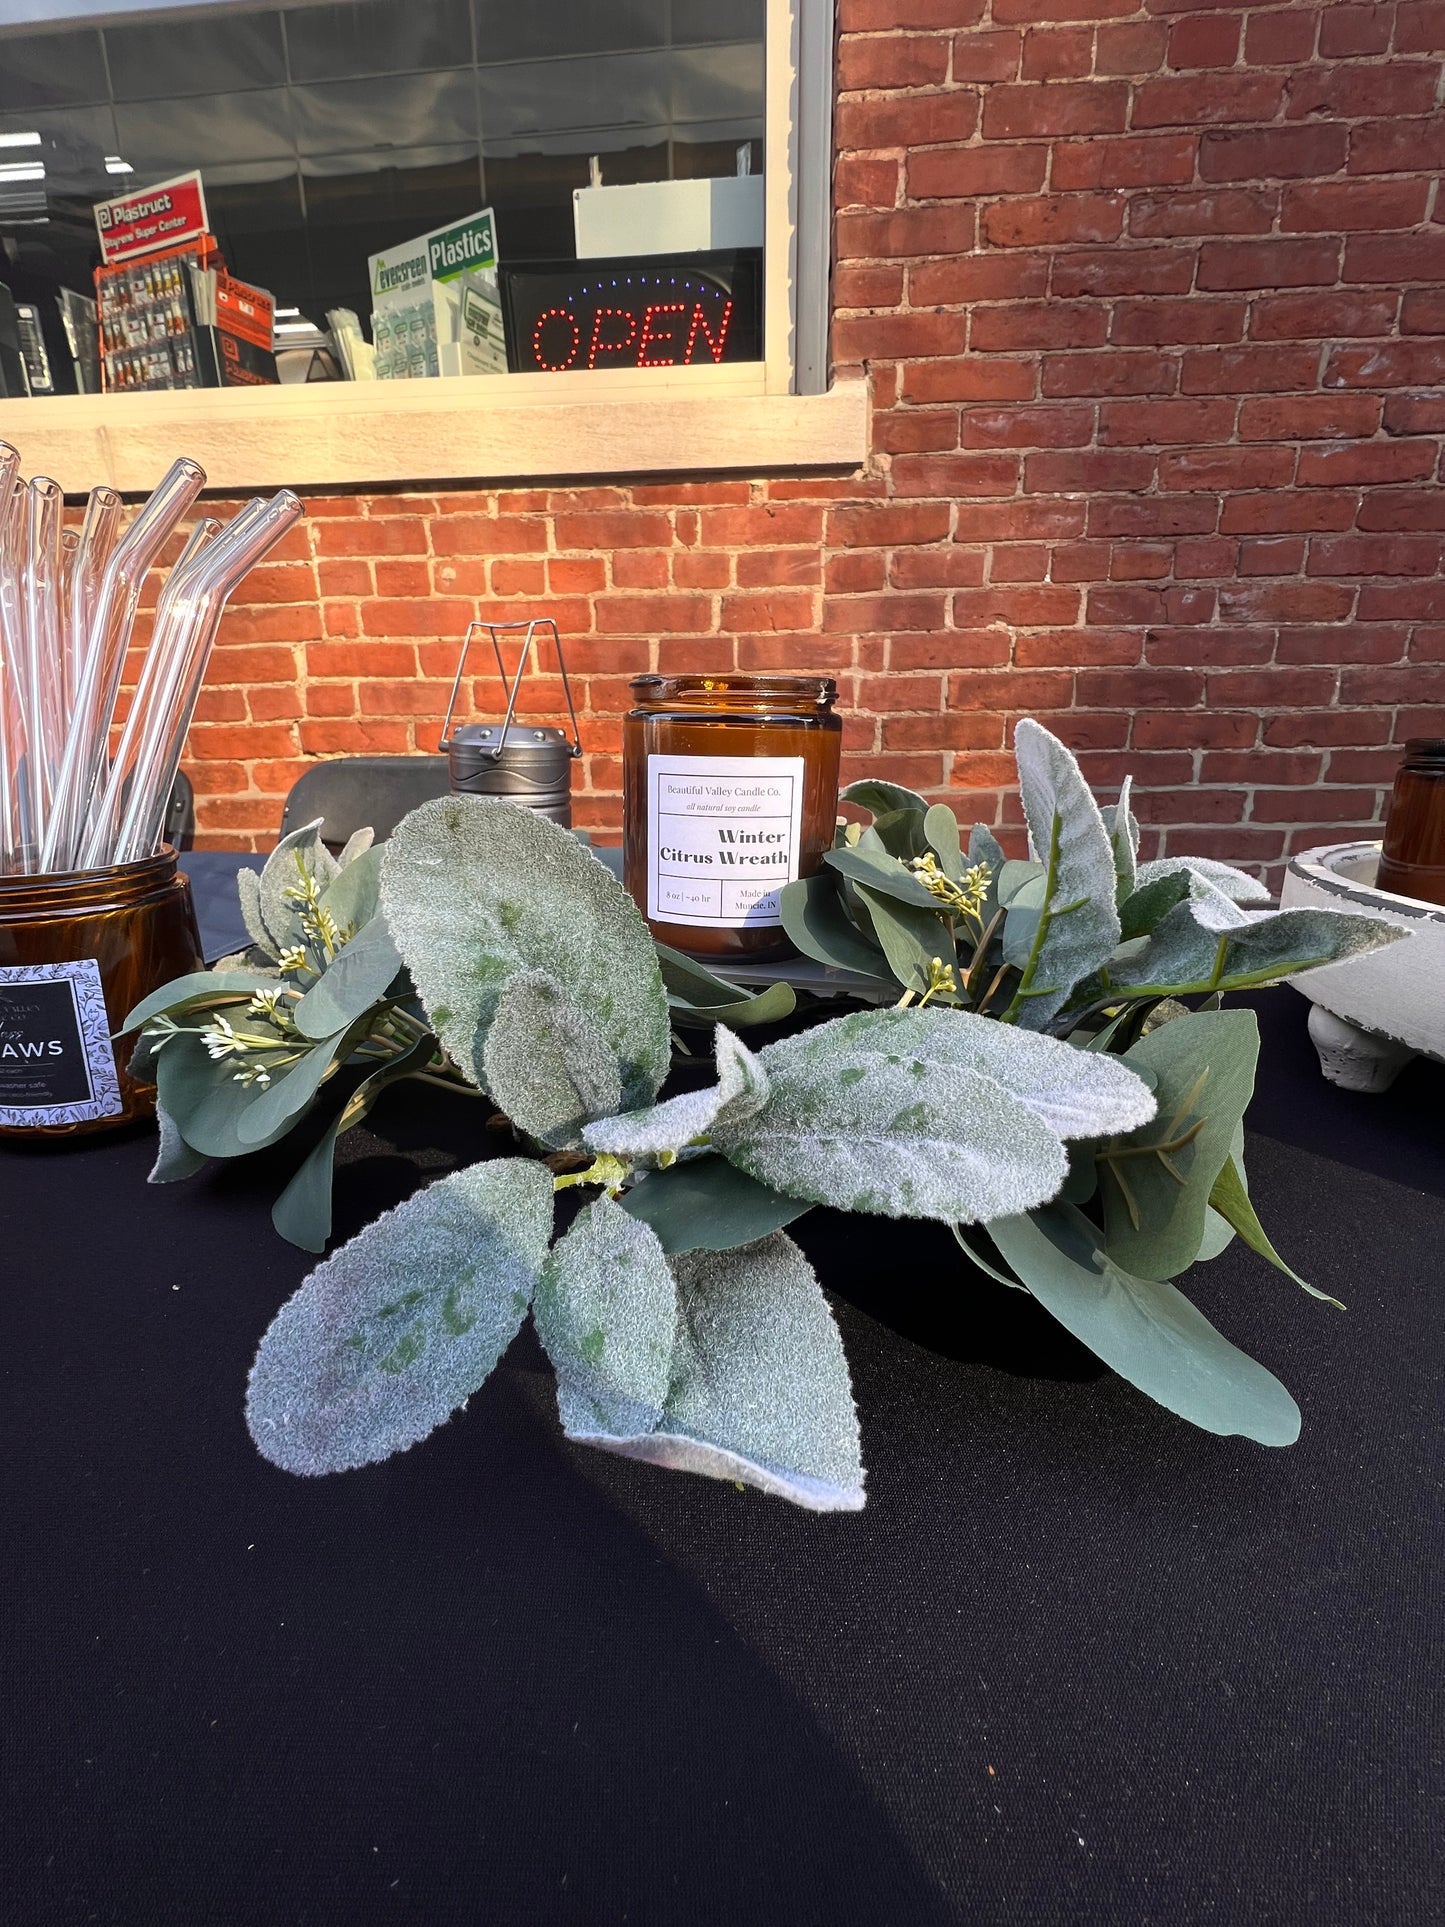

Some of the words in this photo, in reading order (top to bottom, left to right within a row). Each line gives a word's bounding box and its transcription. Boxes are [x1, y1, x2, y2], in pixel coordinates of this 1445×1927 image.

[113, 194, 172, 225] Plastruct
[135, 225, 158, 240] Super
[159, 216, 187, 232] Center
[431, 229, 493, 271] Plastics
[379, 255, 428, 289] evergreen
[533, 300, 734, 372] OPEN
[667, 785, 704, 795] Beautiful
[705, 787, 733, 797] Valley
[734, 788, 765, 797] Candle
[767, 788, 781, 797] Co.
[686, 803, 696, 811] all
[697, 804, 723, 812] natural
[737, 804, 761, 812] candle
[718, 829, 786, 844] Winter
[660, 847, 713, 865] Citrus
[718, 851, 788, 865] Wreath
[740, 890, 762, 898] Made
[763, 890, 771, 898] in
[767, 901, 777, 909] IN
